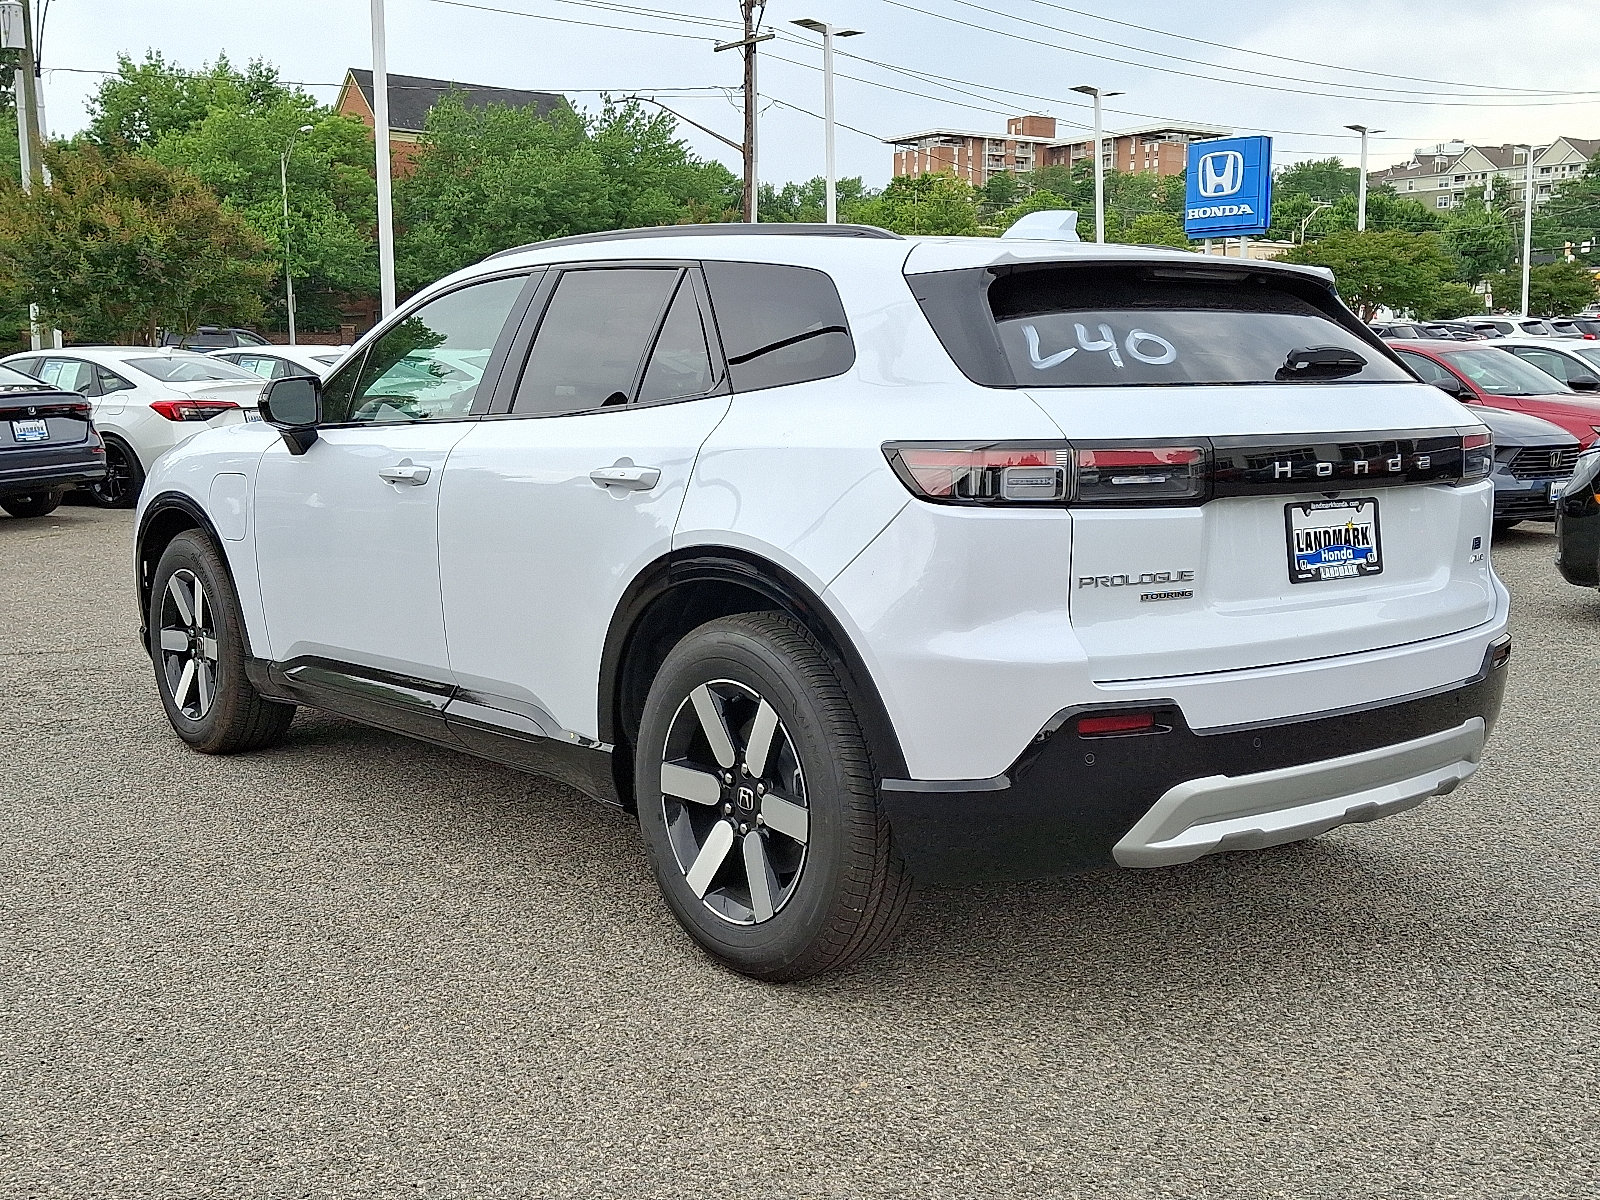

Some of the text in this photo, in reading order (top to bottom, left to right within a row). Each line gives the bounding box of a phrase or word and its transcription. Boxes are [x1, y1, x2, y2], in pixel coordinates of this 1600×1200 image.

[1187, 203, 1254, 219] HONDA
[1020, 322, 1177, 370] L40
[1273, 453, 1432, 479] Honda
[1295, 525, 1371, 553] LANDMARK
[1321, 547, 1354, 562] Honda
[1078, 570, 1195, 589] PROLOGUE
[1319, 564, 1360, 580] LANDMARK
